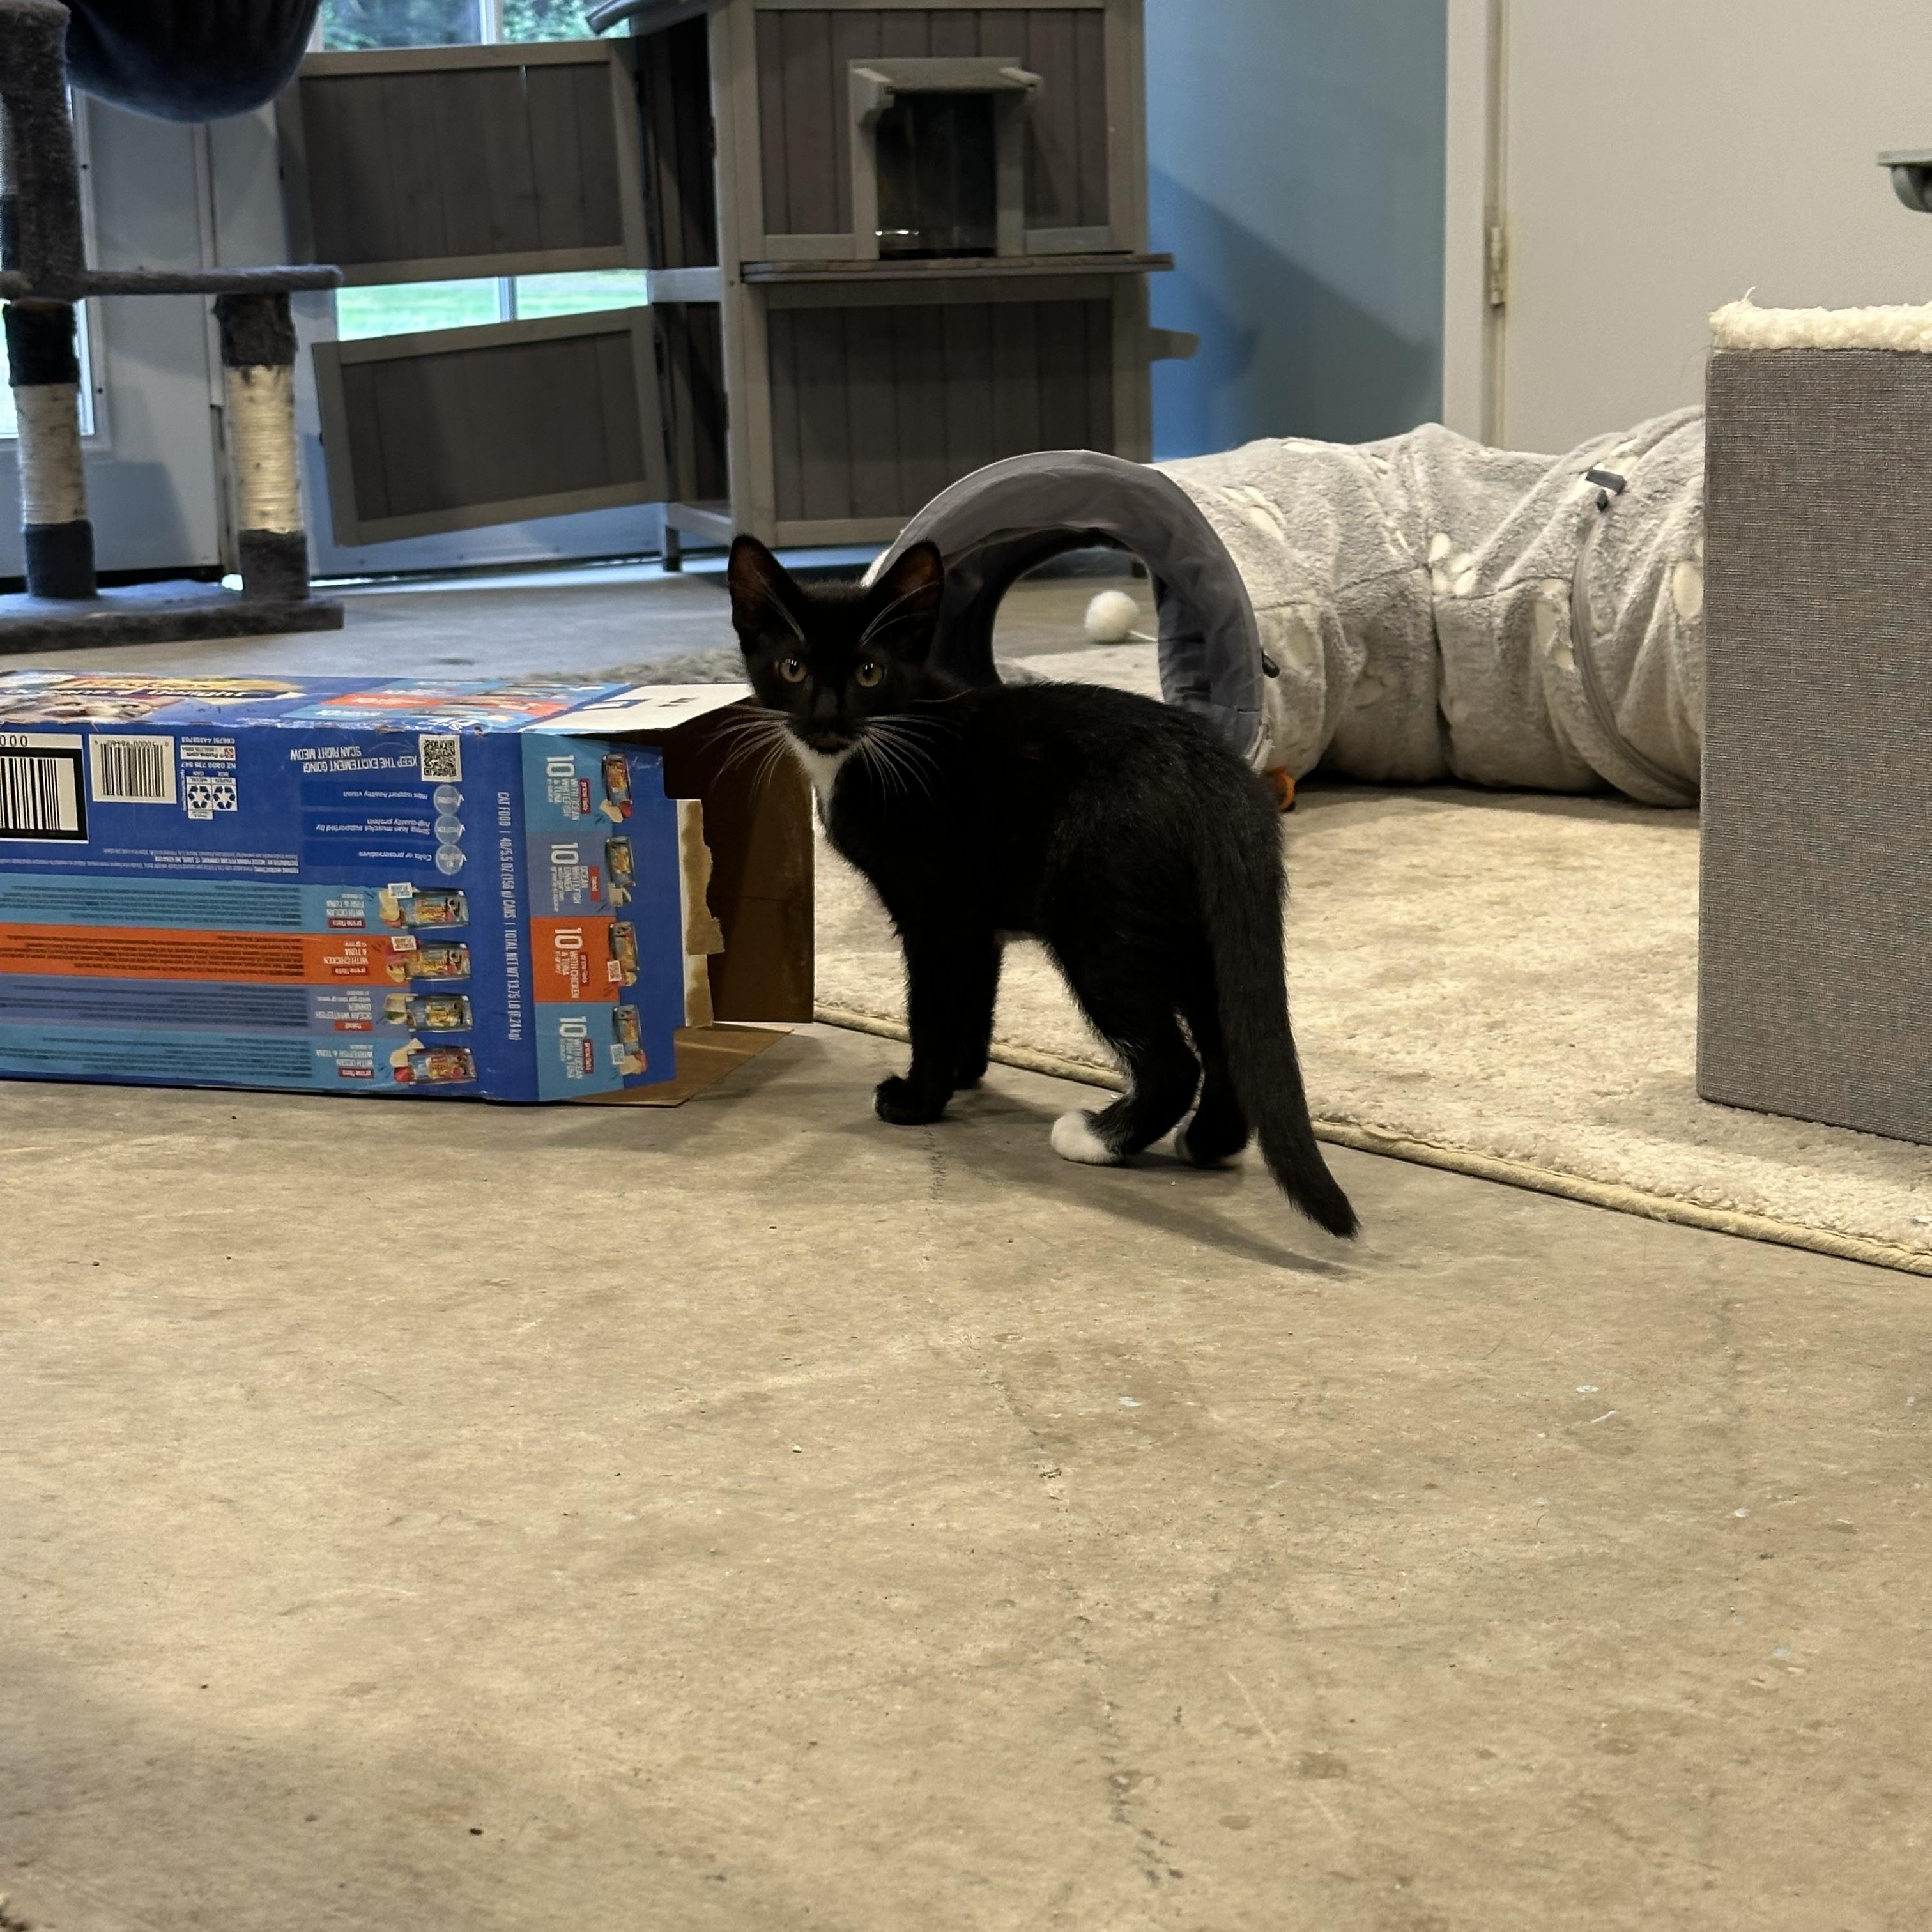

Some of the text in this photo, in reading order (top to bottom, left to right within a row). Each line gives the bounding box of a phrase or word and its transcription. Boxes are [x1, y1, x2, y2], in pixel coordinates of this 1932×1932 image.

[290, 746, 362, 760] SCAN RIGHT MEOW
[303, 756, 417, 772] KEEP THE EXCITEMENT GOING!
[546, 755, 575, 777] 10
[497, 792, 510, 805] CAT
[498, 806, 511, 827] FOOD
[551, 842, 579, 864] 10
[503, 900, 516, 919] CANS
[505, 929, 519, 951] TOTAL
[555, 928, 583, 949] 10
[505, 952, 519, 965] NET
[506, 967, 519, 977] WT
[559, 1016, 588, 1038] 10
